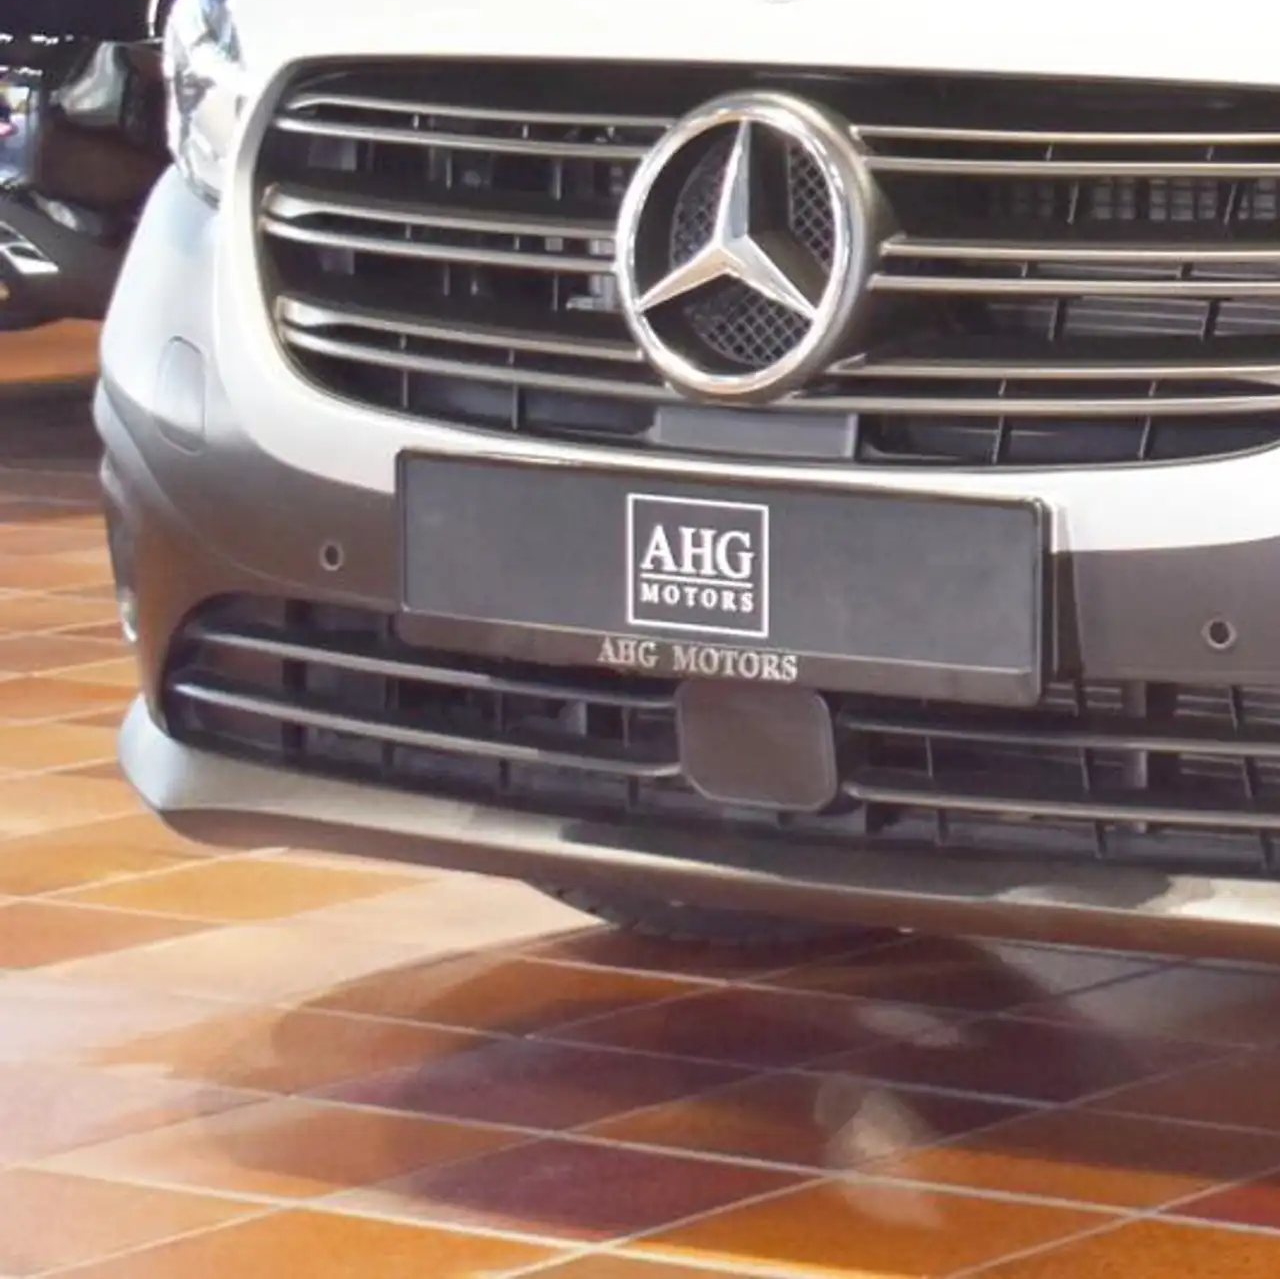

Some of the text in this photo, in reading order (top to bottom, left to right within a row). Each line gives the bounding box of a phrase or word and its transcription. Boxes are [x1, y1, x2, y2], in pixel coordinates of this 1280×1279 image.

[640, 525, 754, 579] AHG
[640, 583, 754, 612] MOTORS
[598, 637, 798, 683] AHG MOTORS
